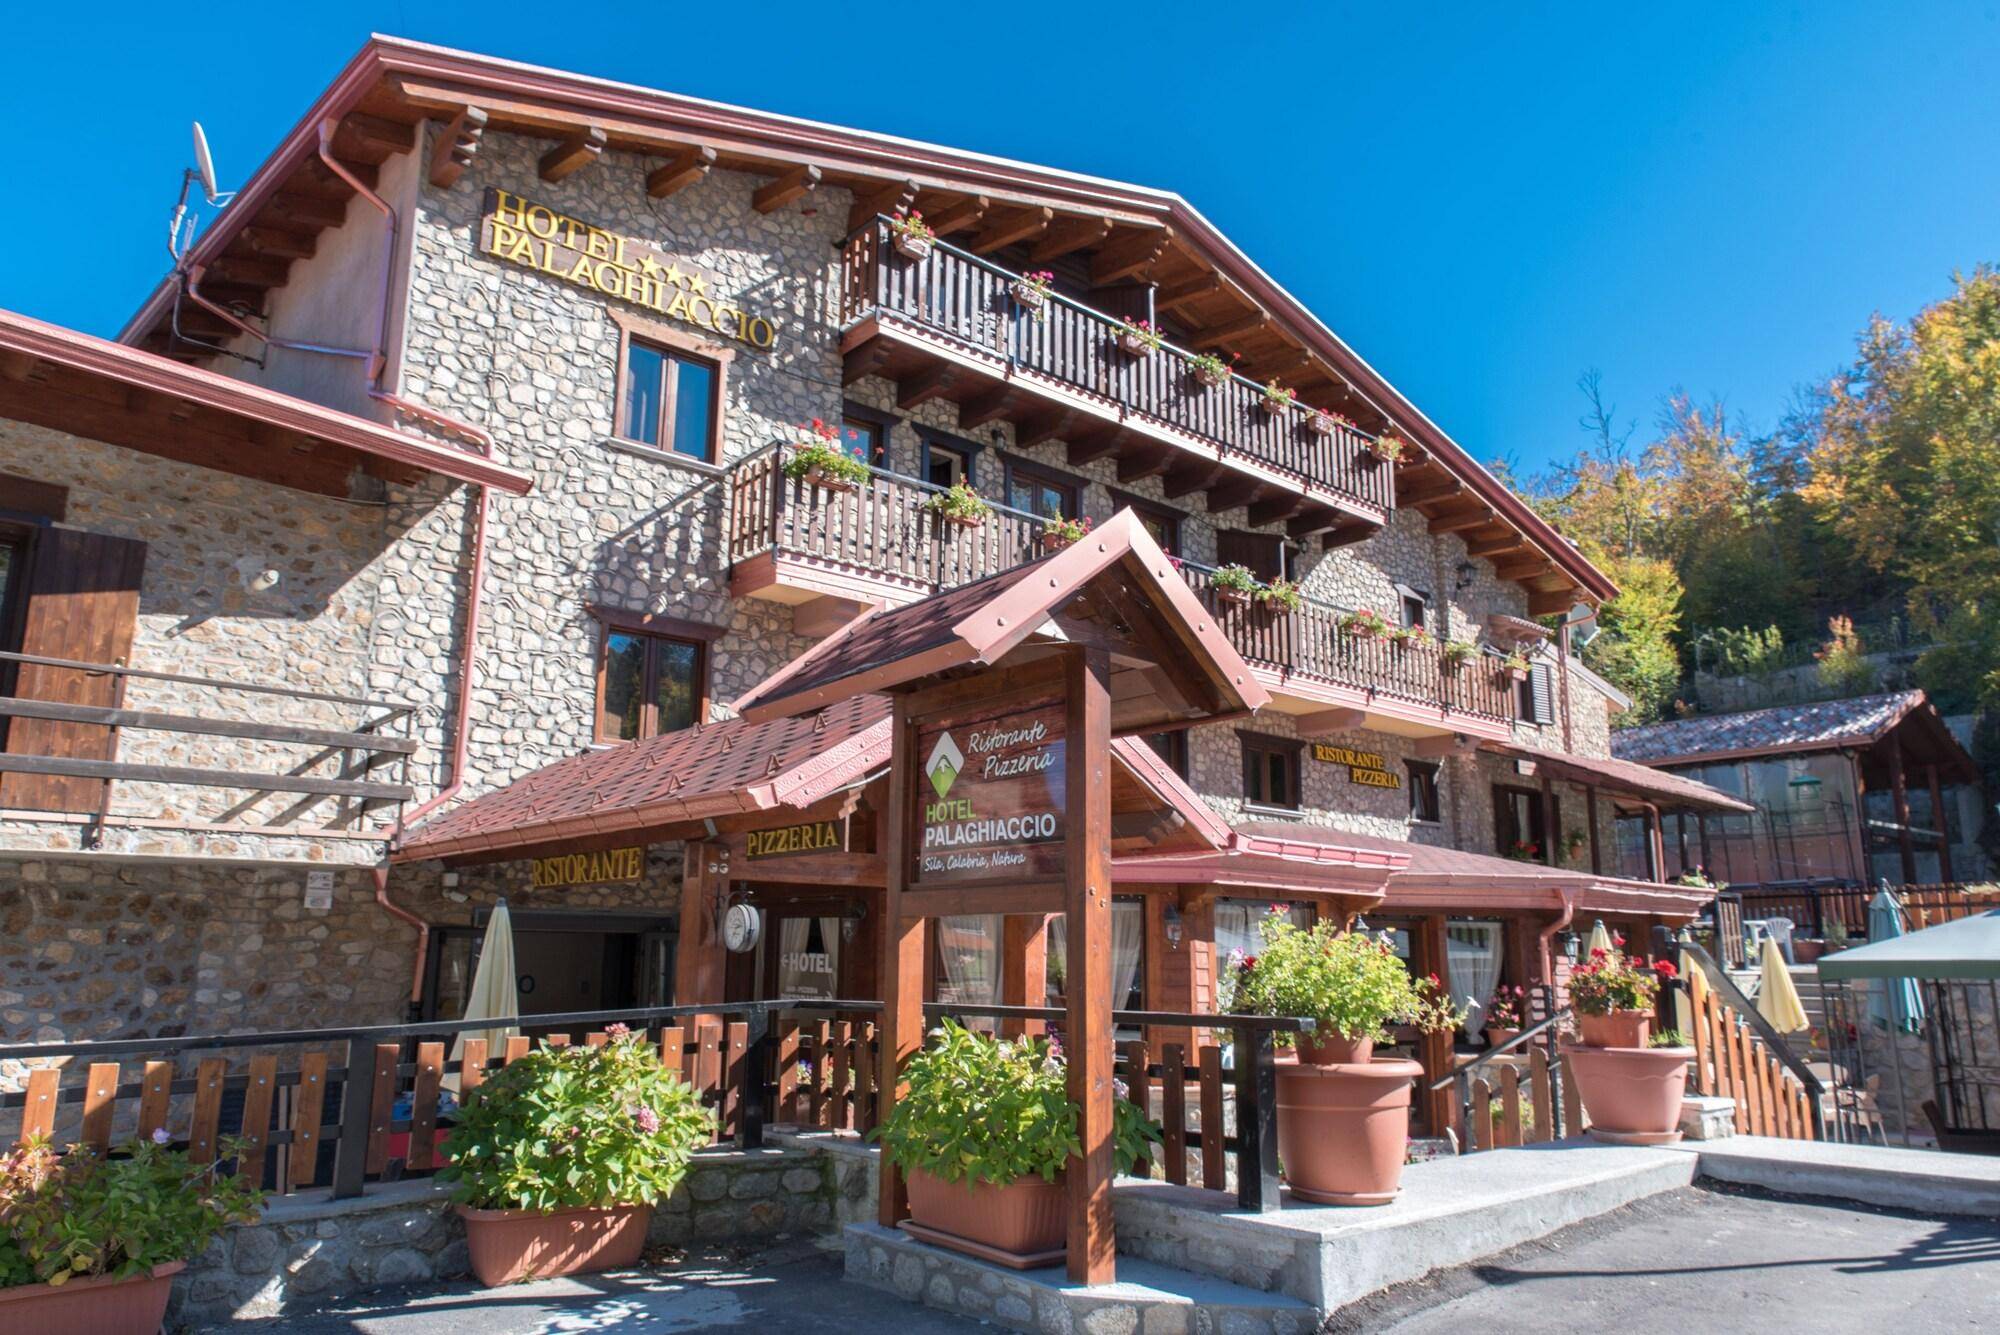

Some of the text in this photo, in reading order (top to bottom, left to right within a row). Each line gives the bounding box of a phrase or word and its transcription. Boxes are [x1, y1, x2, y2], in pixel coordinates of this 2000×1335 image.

[491, 188, 638, 271] HOTEL
[488, 222, 775, 348] PALAGHIACCIO
[968, 720, 1047, 753] Ristorante
[984, 747, 1056, 779] Pizzeria
[1315, 744, 1384, 769] RISTORANTE
[1353, 769, 1400, 788] PIZZERIA
[926, 799, 977, 823] HOTEL
[747, 823, 839, 857] PIZZERIA
[925, 814, 1056, 847] PALAGHIACCIO
[532, 847, 641, 887] RISTORANTE
[924, 851, 1027, 872] Sila, Calabria, Natura
[790, 952, 833, 974] HOTEL
